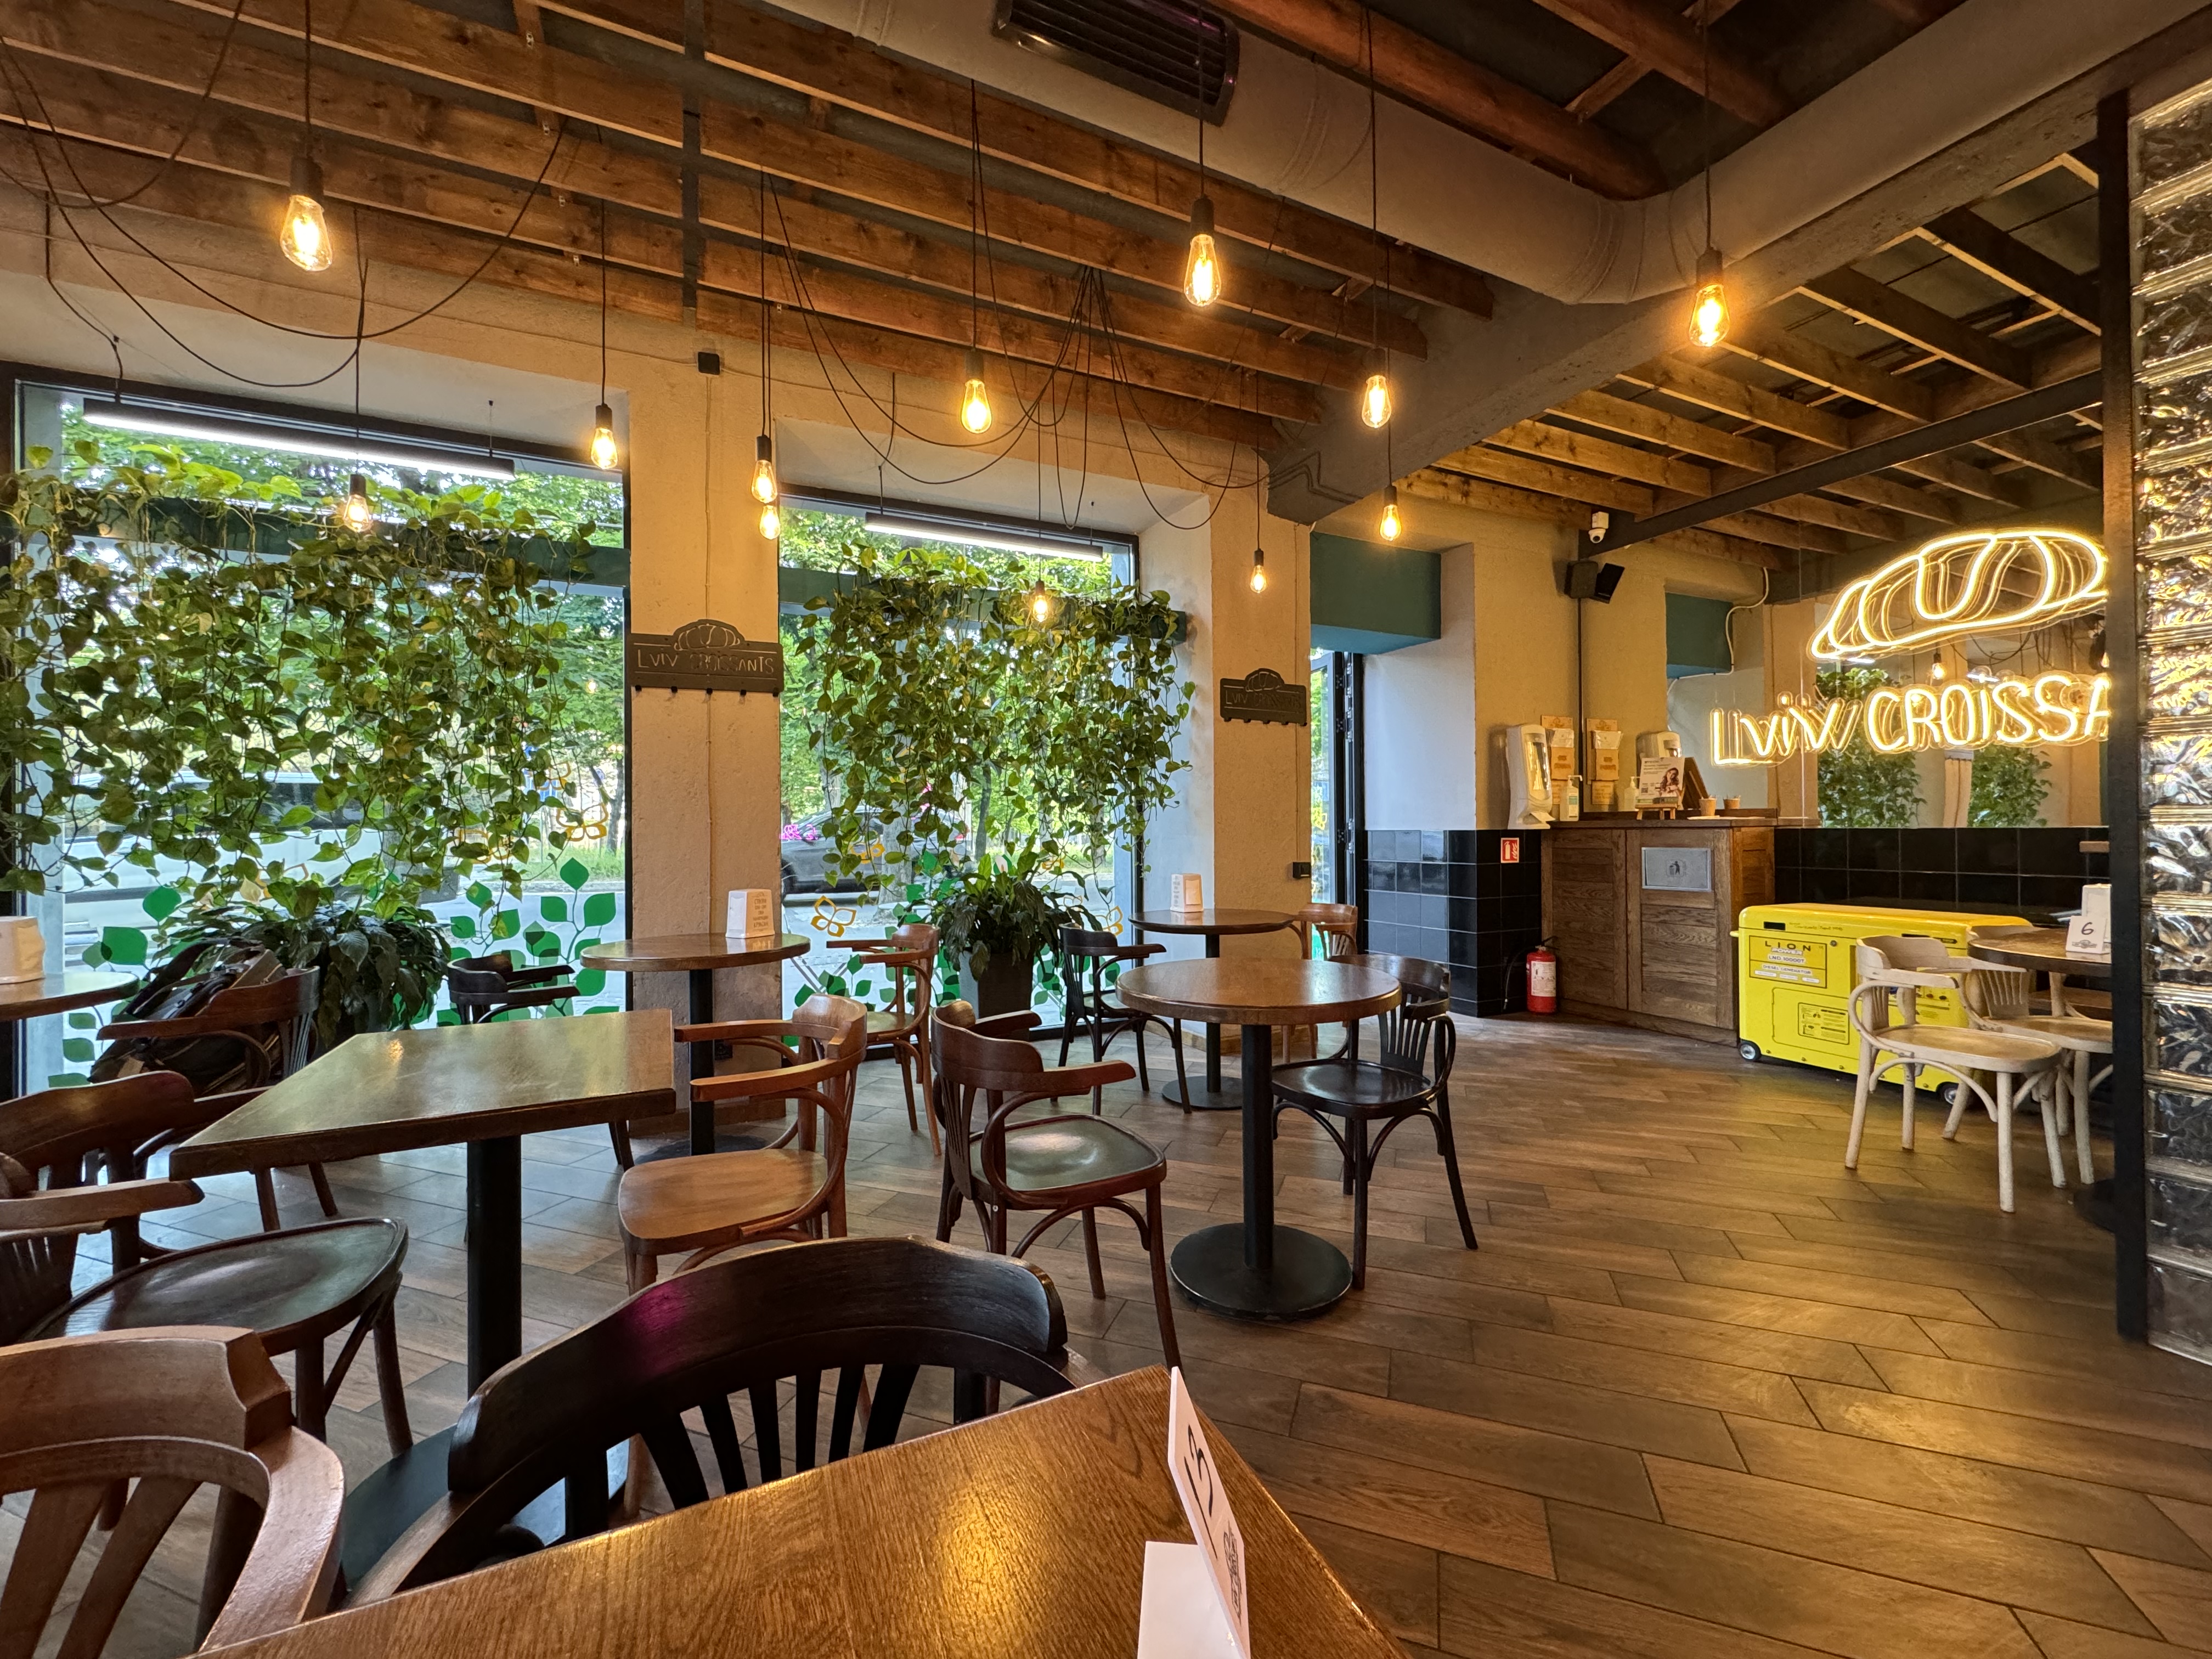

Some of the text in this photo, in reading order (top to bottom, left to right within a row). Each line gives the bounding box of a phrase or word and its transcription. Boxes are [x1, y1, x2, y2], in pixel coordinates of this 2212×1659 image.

[2081, 922, 2095, 935] 6
[1765, 940, 1812, 952] LION
[1771, 947, 1803, 956] POWER
